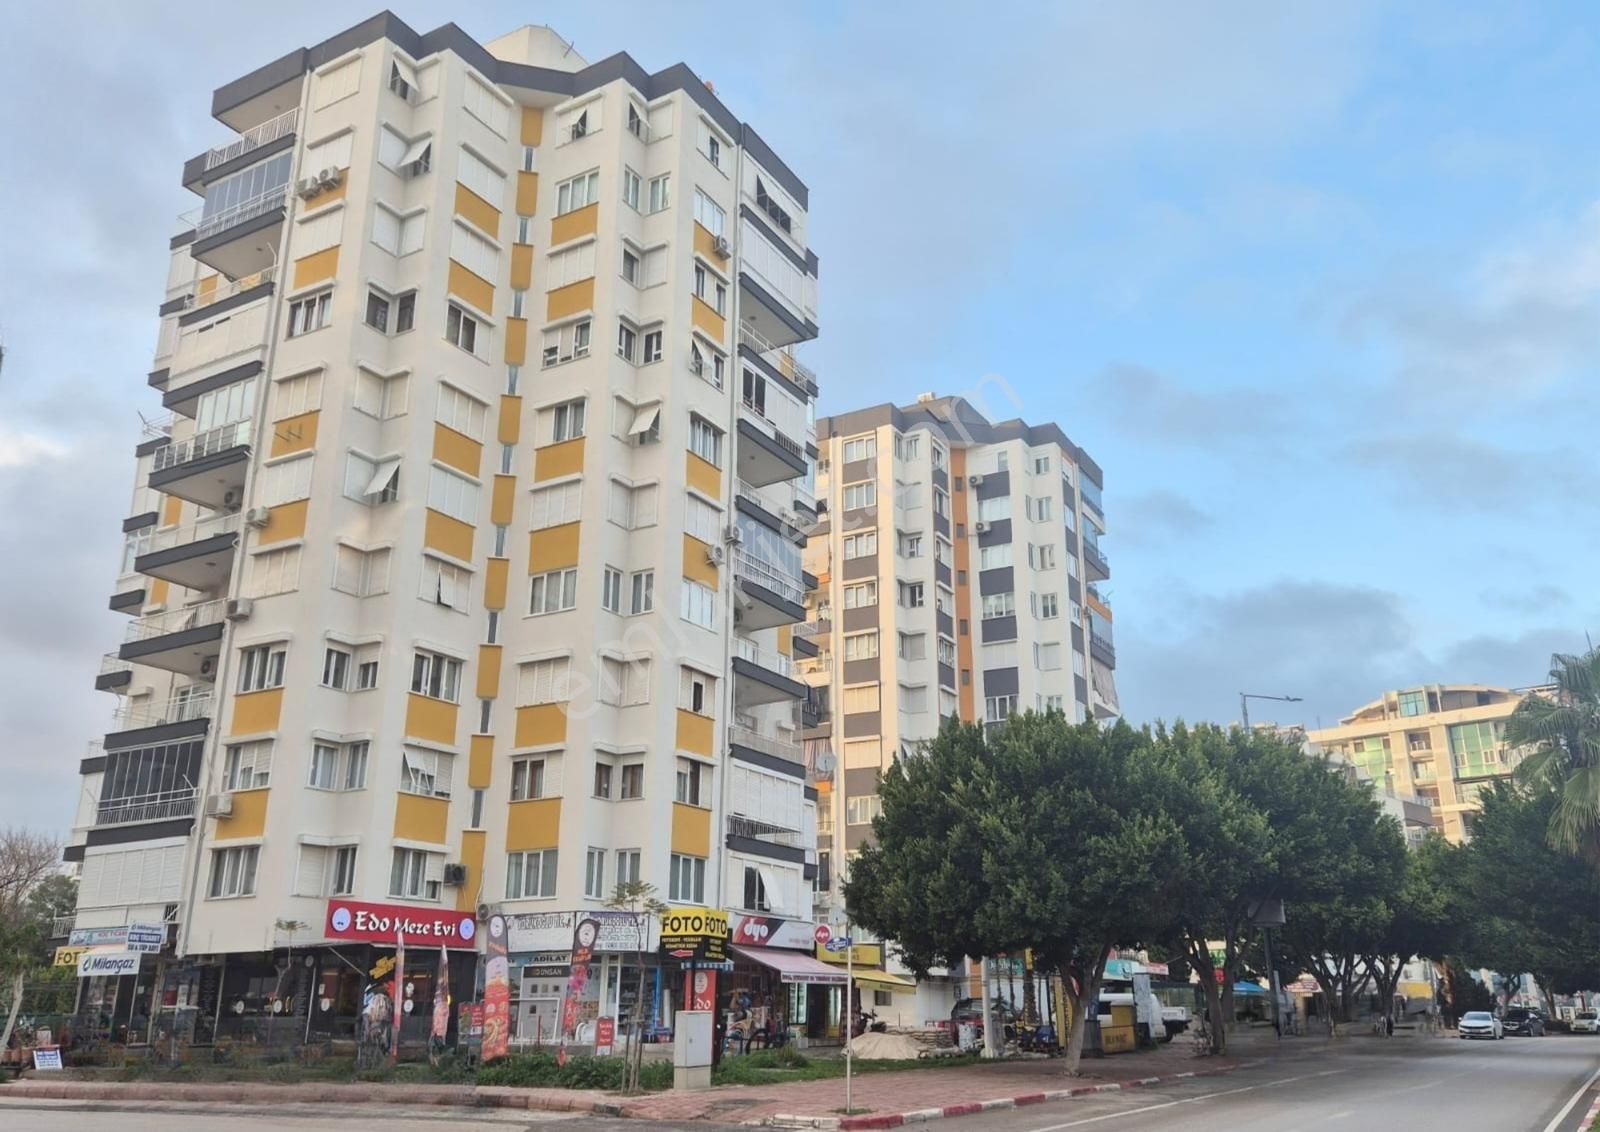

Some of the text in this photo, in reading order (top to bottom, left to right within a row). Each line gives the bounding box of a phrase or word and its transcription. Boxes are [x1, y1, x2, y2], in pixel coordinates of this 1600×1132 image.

[354, 910, 456, 937] Edo Meze Evi
[662, 916, 703, 933] FOTO
[704, 917, 728, 935] FOTO
[743, 918, 769, 941] dyo
[91, 957, 135, 974] Milangaz
[694, 998, 711, 1010] do
